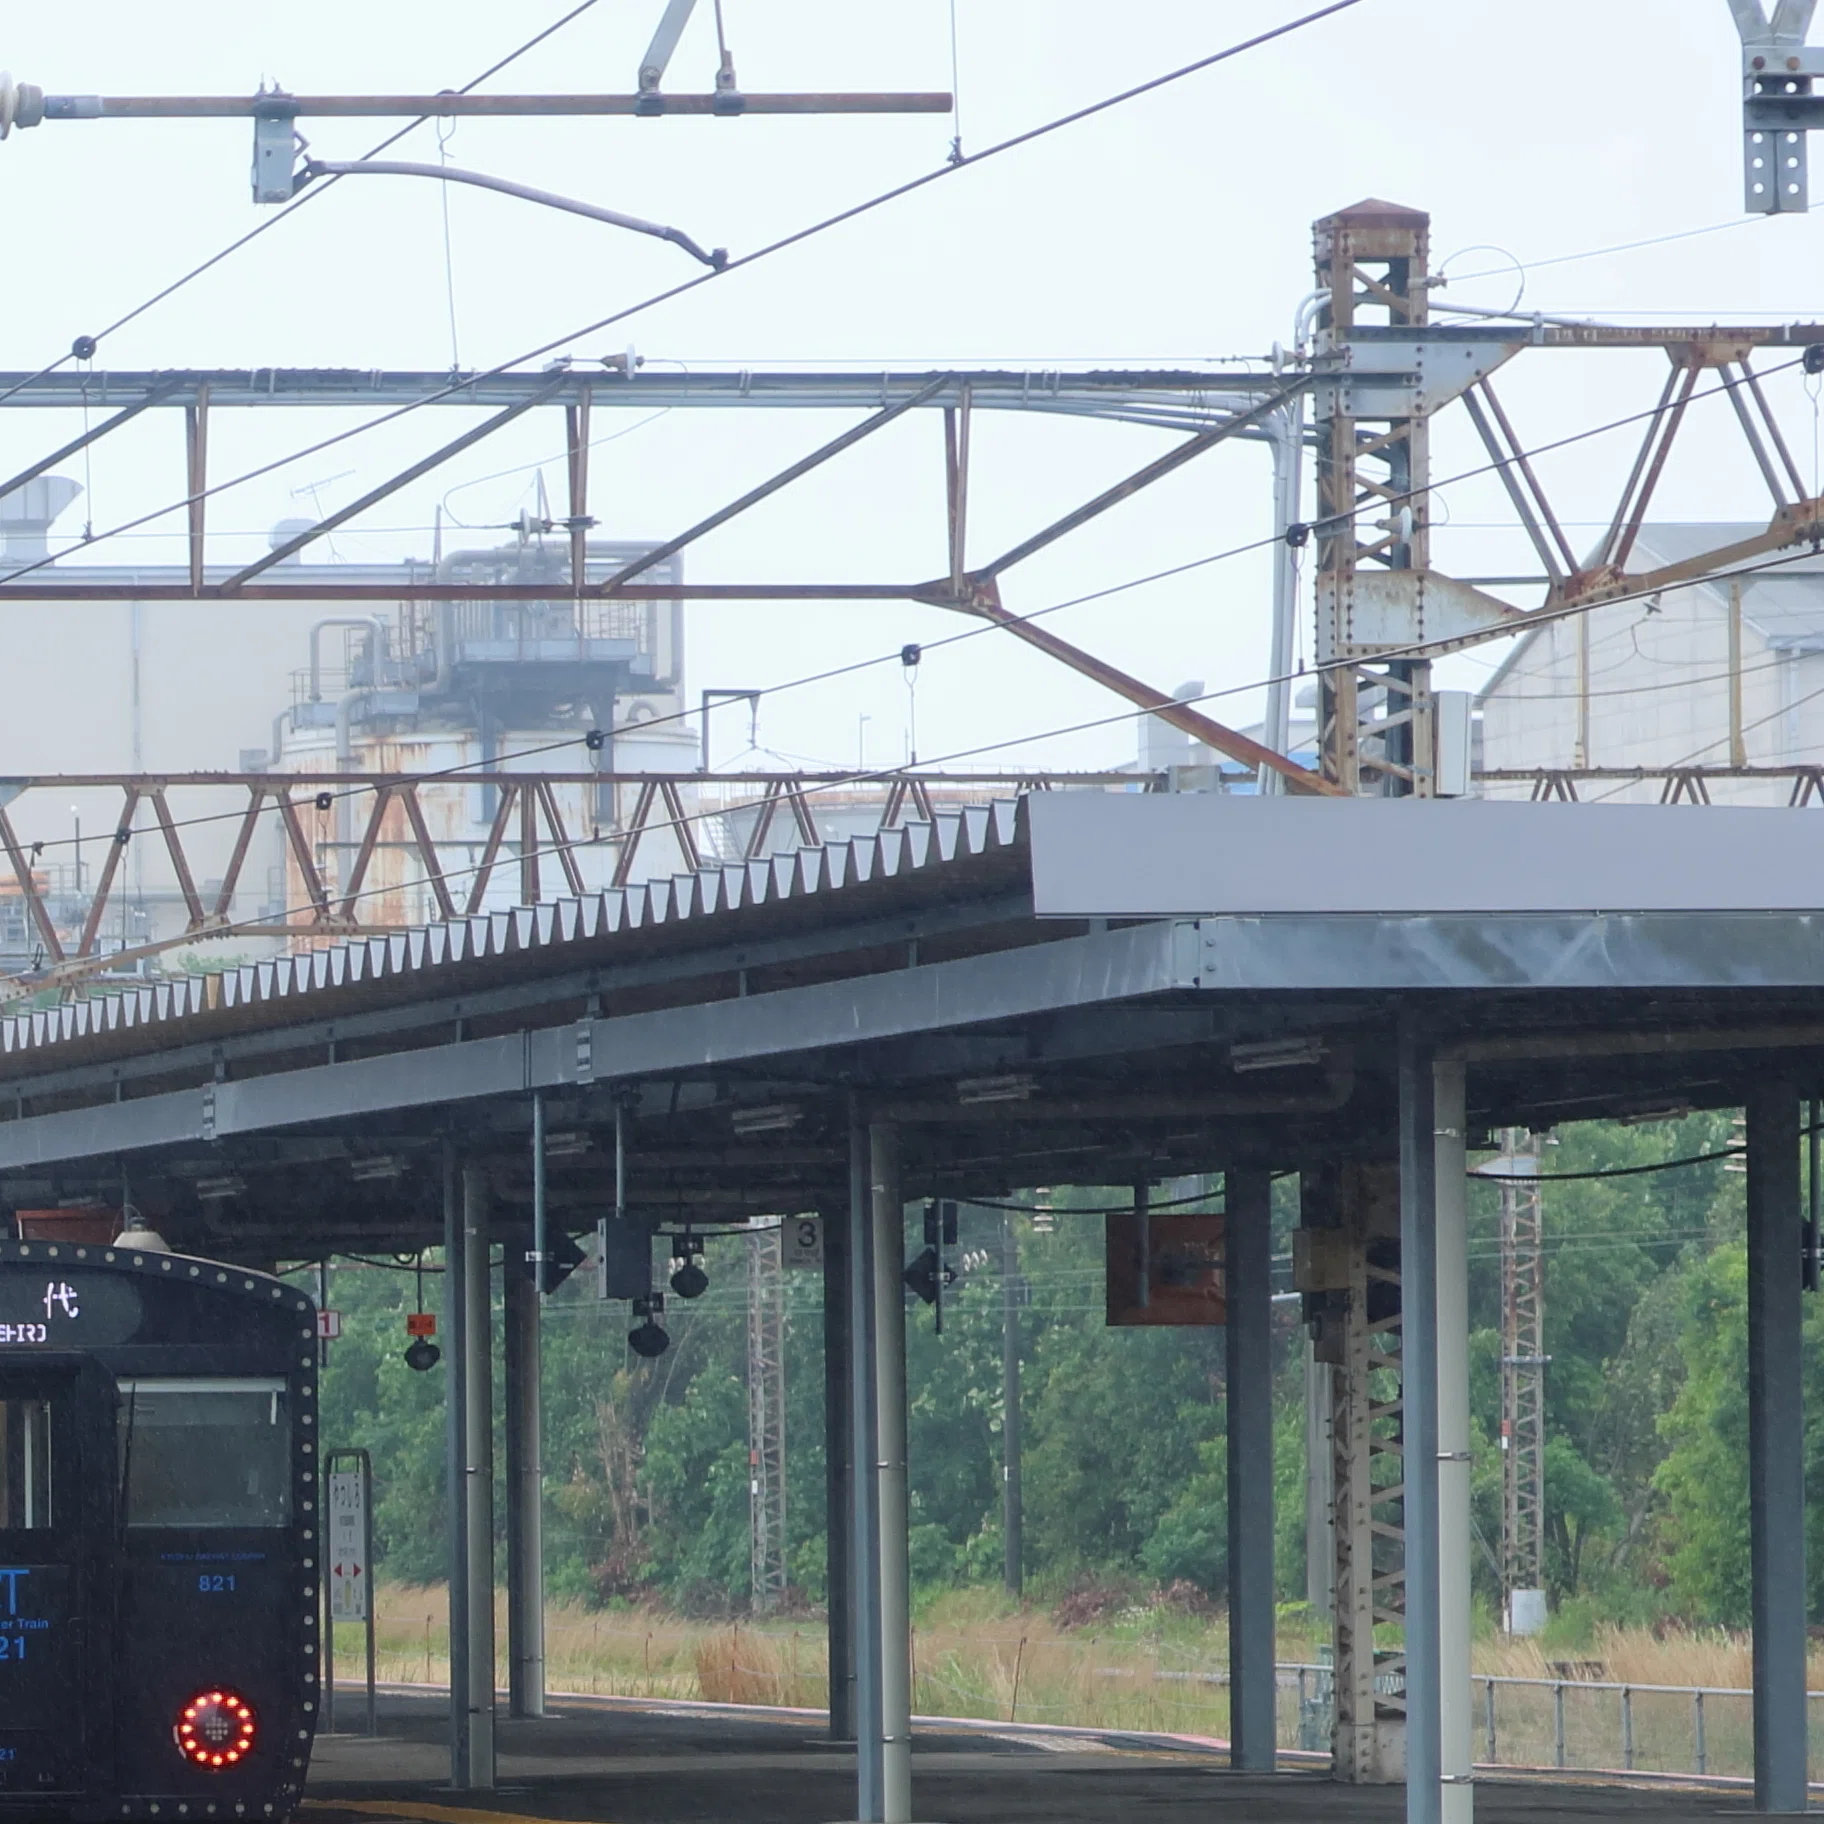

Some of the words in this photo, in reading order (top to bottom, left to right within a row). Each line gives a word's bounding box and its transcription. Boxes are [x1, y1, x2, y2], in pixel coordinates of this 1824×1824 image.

[798, 1221, 816, 1247] 3
[318, 1313, 330, 1333] 1
[198, 1574, 236, 1592] 821
[17, 1618, 49, 1630] Train
